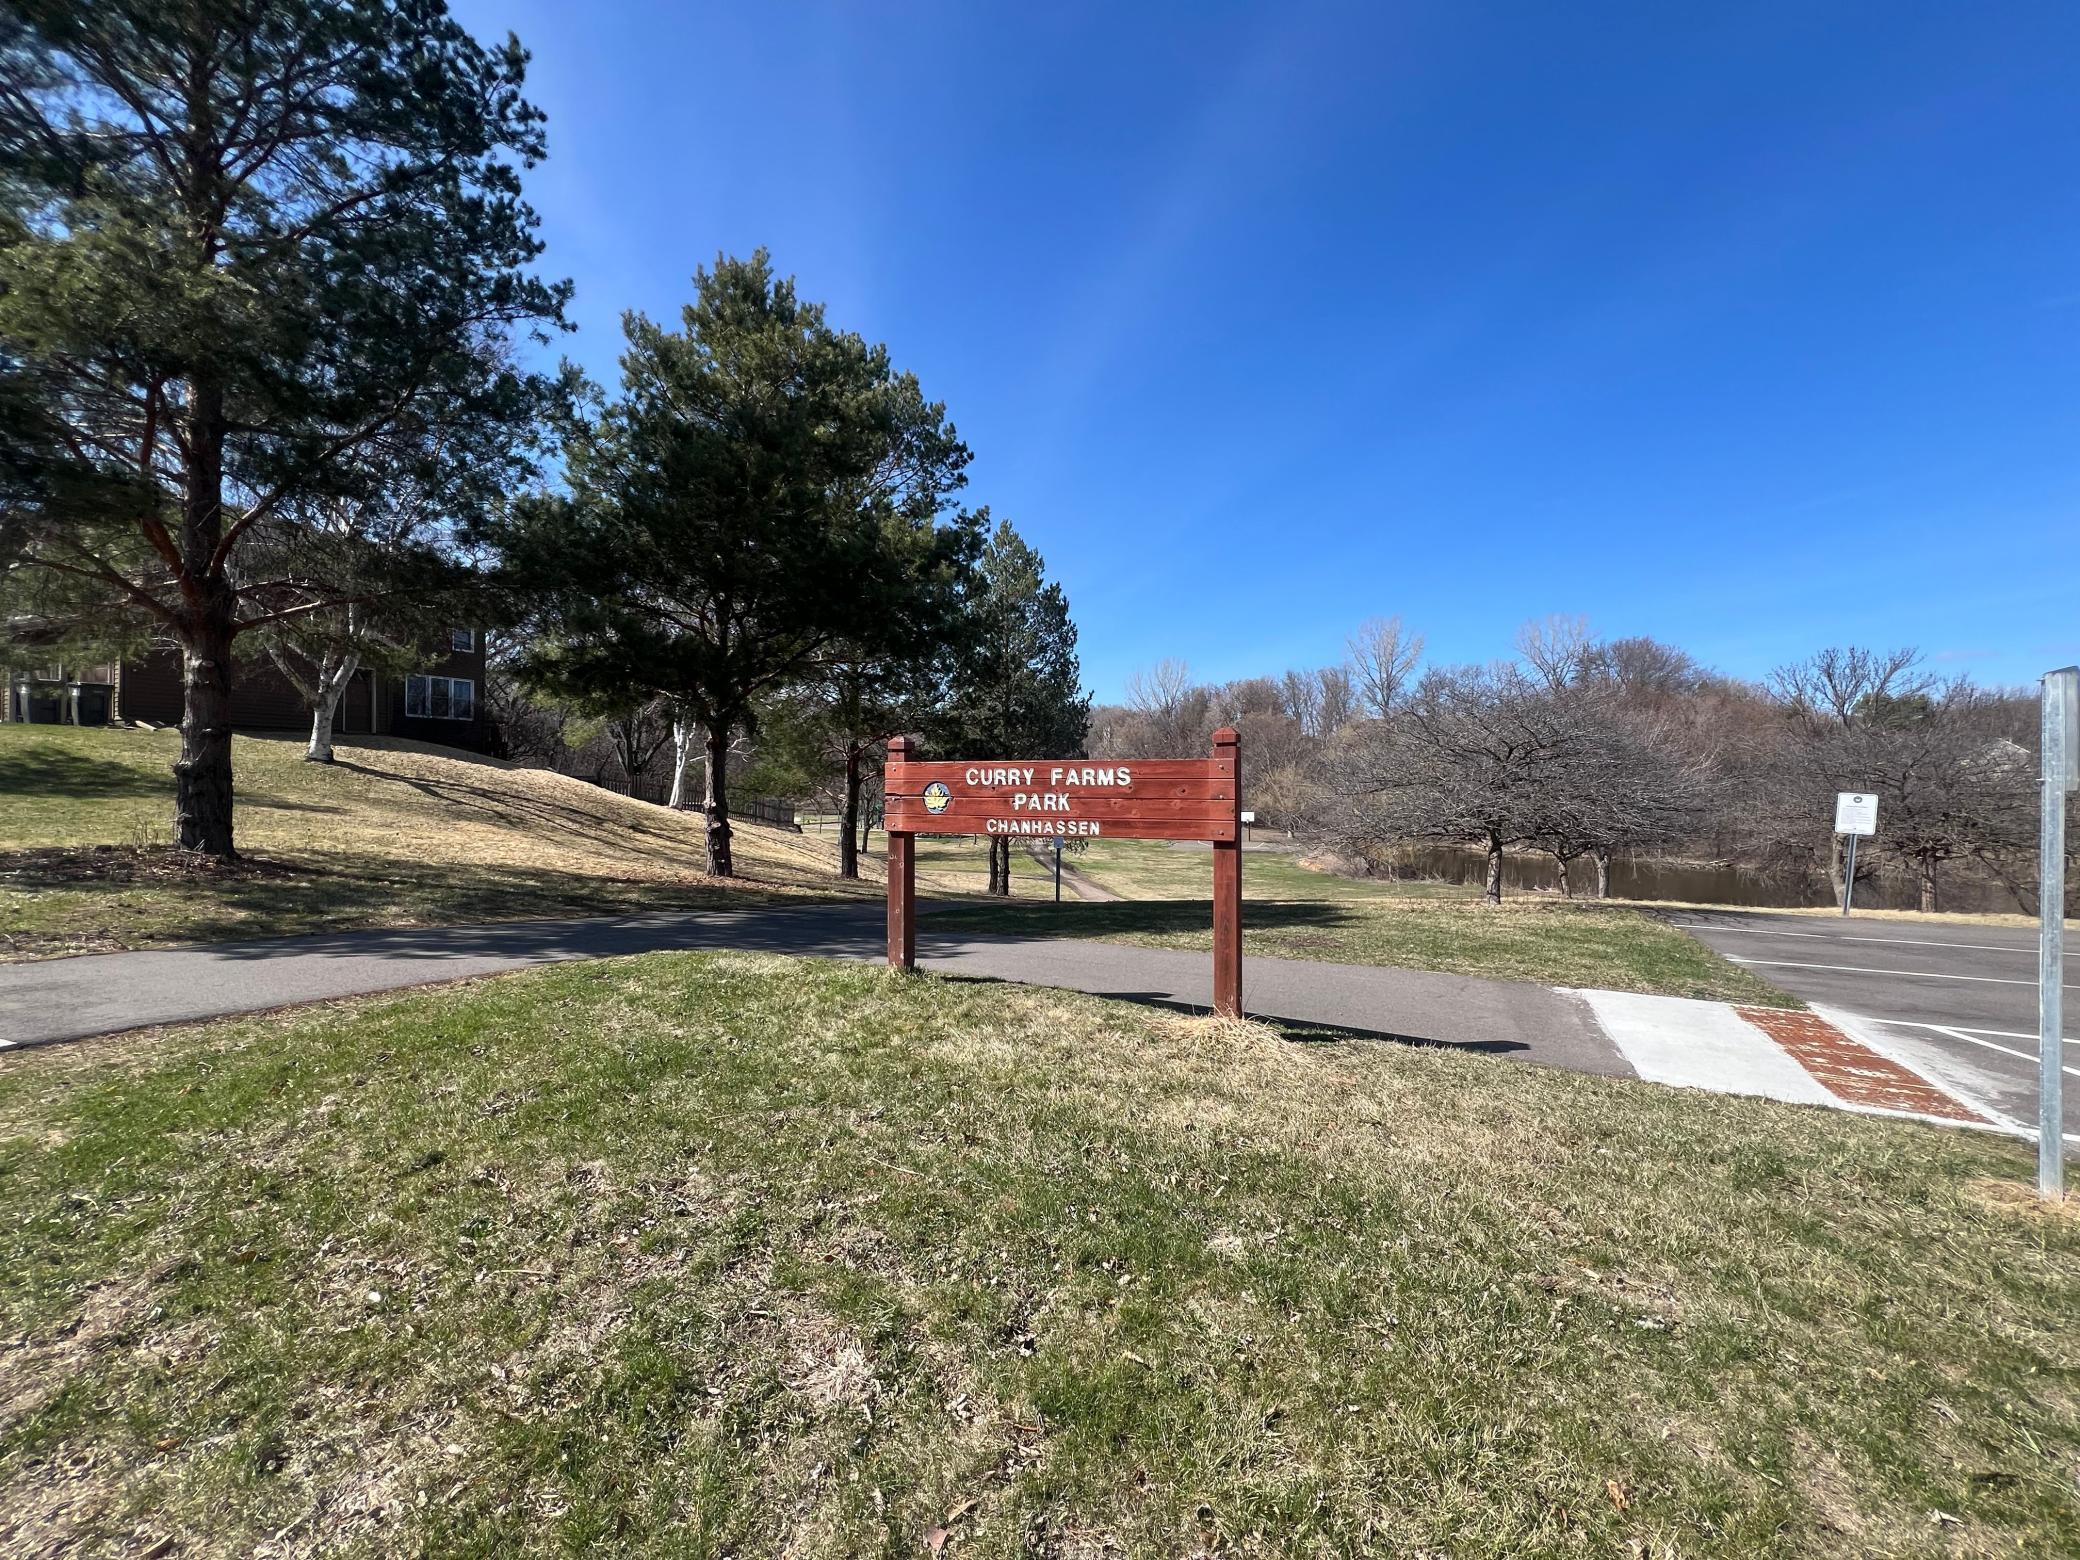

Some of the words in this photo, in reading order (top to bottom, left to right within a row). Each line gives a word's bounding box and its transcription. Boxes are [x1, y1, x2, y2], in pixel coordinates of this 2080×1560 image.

[965, 767, 1035, 785] CURRY
[1051, 766, 1131, 786] FARMS
[1013, 793, 1071, 811] PARK
[986, 818, 1100, 835] CHANHASSEN
